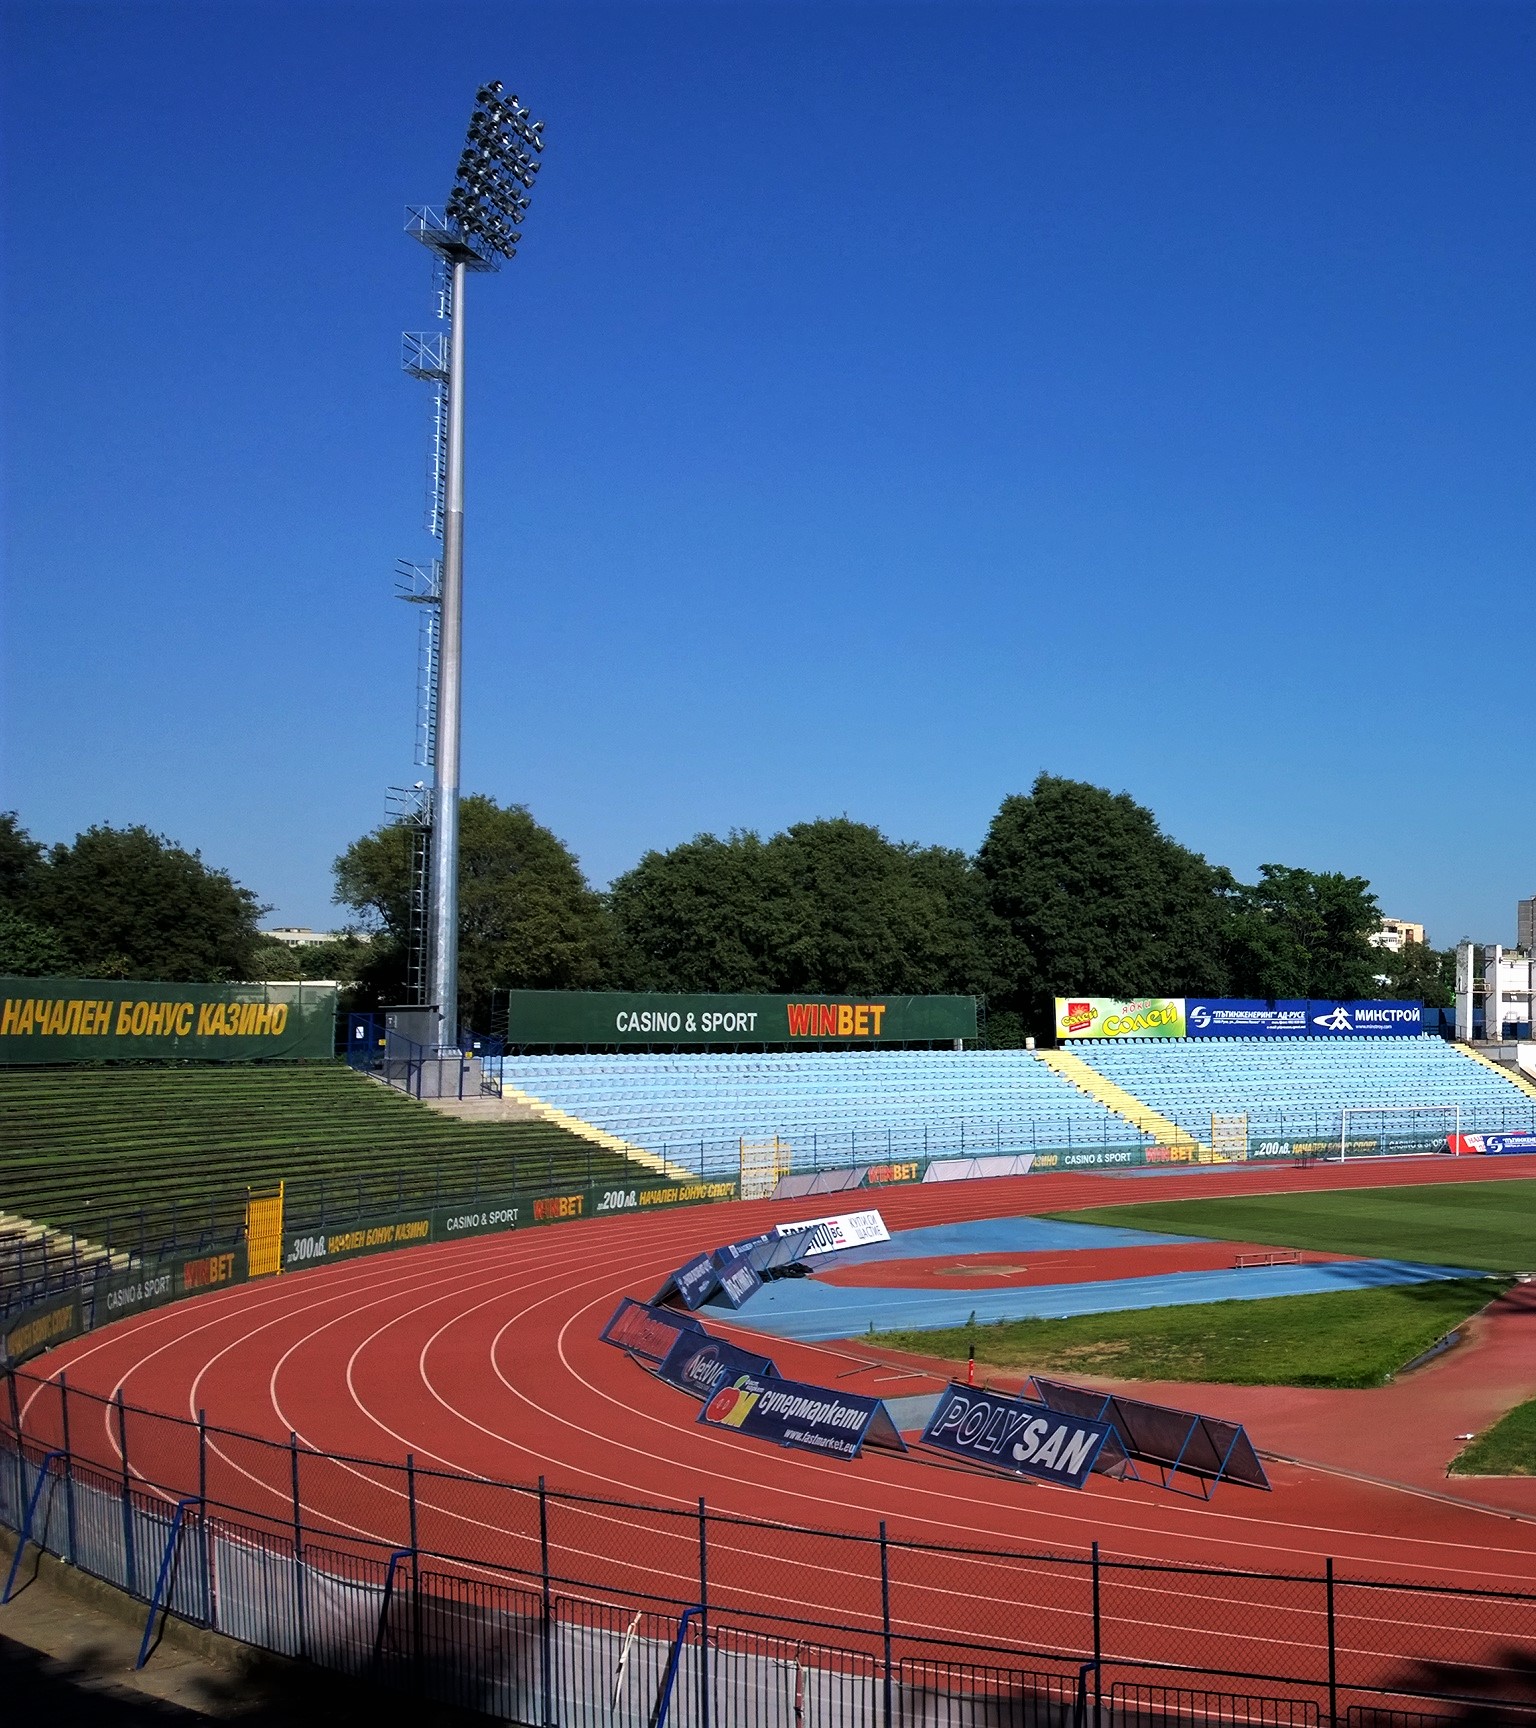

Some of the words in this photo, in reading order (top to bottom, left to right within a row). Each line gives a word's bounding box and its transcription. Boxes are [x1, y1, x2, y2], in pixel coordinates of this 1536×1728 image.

[1, 999, 112, 1035] НАЧАЛЕН
[116, 1001, 193, 1035] БОНУС
[196, 1002, 289, 1036] КАЗИНО
[616, 1011, 681, 1032] CASINO
[685, 1012, 697, 1032] &
[701, 1012, 757, 1032] SPORT
[787, 1003, 885, 1036] WINBET
[1355, 1007, 1420, 1021] МИНСТРОЙ
[1065, 1155, 1096, 1165] CASINO
[1097, 1154, 1103, 1163] &
[1104, 1152, 1131, 1163] SPORT
[868, 1162, 918, 1183] WINBET
[639, 1187, 678, 1206] НАЧАЛЕН
[679, 1184, 707, 1201] БОНУС
[446, 1215, 480, 1231] CASINO
[480, 1213, 488, 1226] &
[489, 1208, 519, 1225] SPORT
[366, 1226, 394, 1247] БОНУС
[831, 1226, 844, 1239] BG
[107, 1285, 136, 1310] CASINO
[136, 1284, 144, 1300] &
[144, 1275, 171, 1298] SPORT
[783, 1427, 857, 1453] www.fastmarket.eu
[930, 1395, 1100, 1475] POLYSAN
